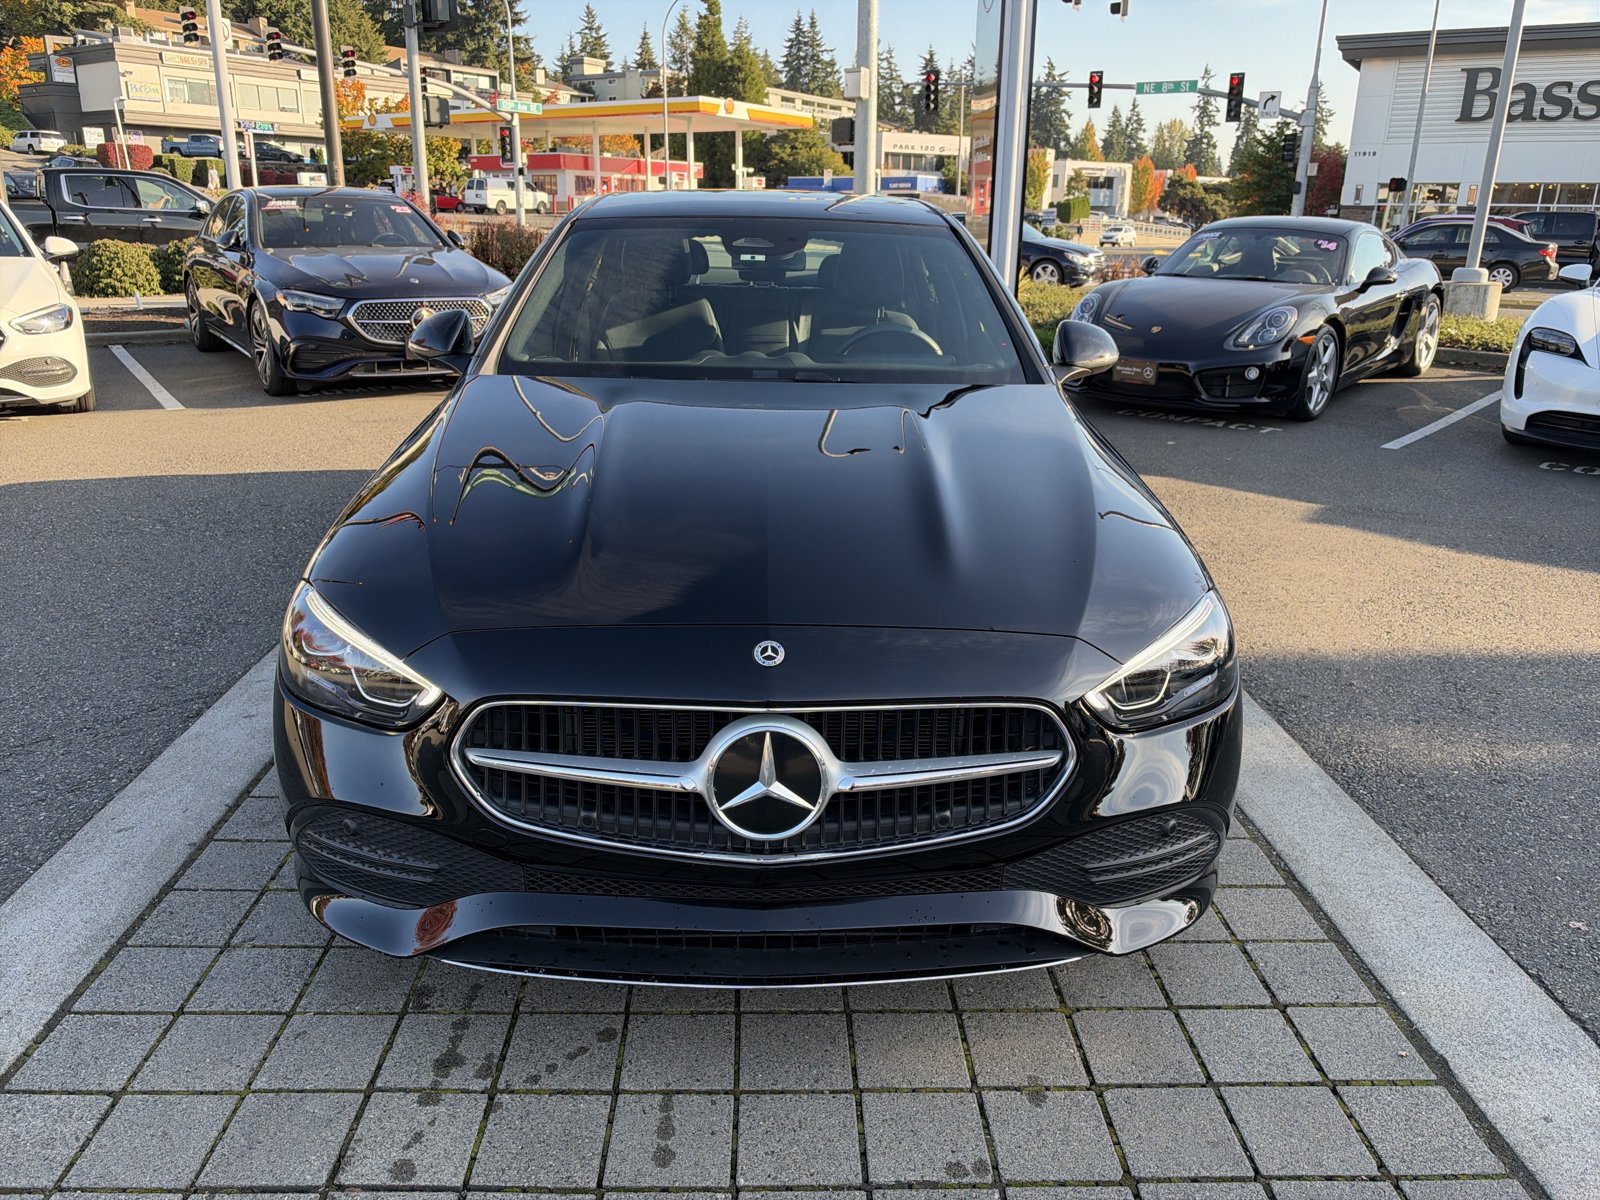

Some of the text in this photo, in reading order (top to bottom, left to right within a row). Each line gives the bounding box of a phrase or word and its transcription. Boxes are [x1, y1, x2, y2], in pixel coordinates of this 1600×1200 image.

[1143, 81, 1190, 93] NE 8th St
[1454, 66, 1600, 122] Bass
[892, 143, 916, 151] PARK
[1116, 408, 1284, 434] COMPACT
